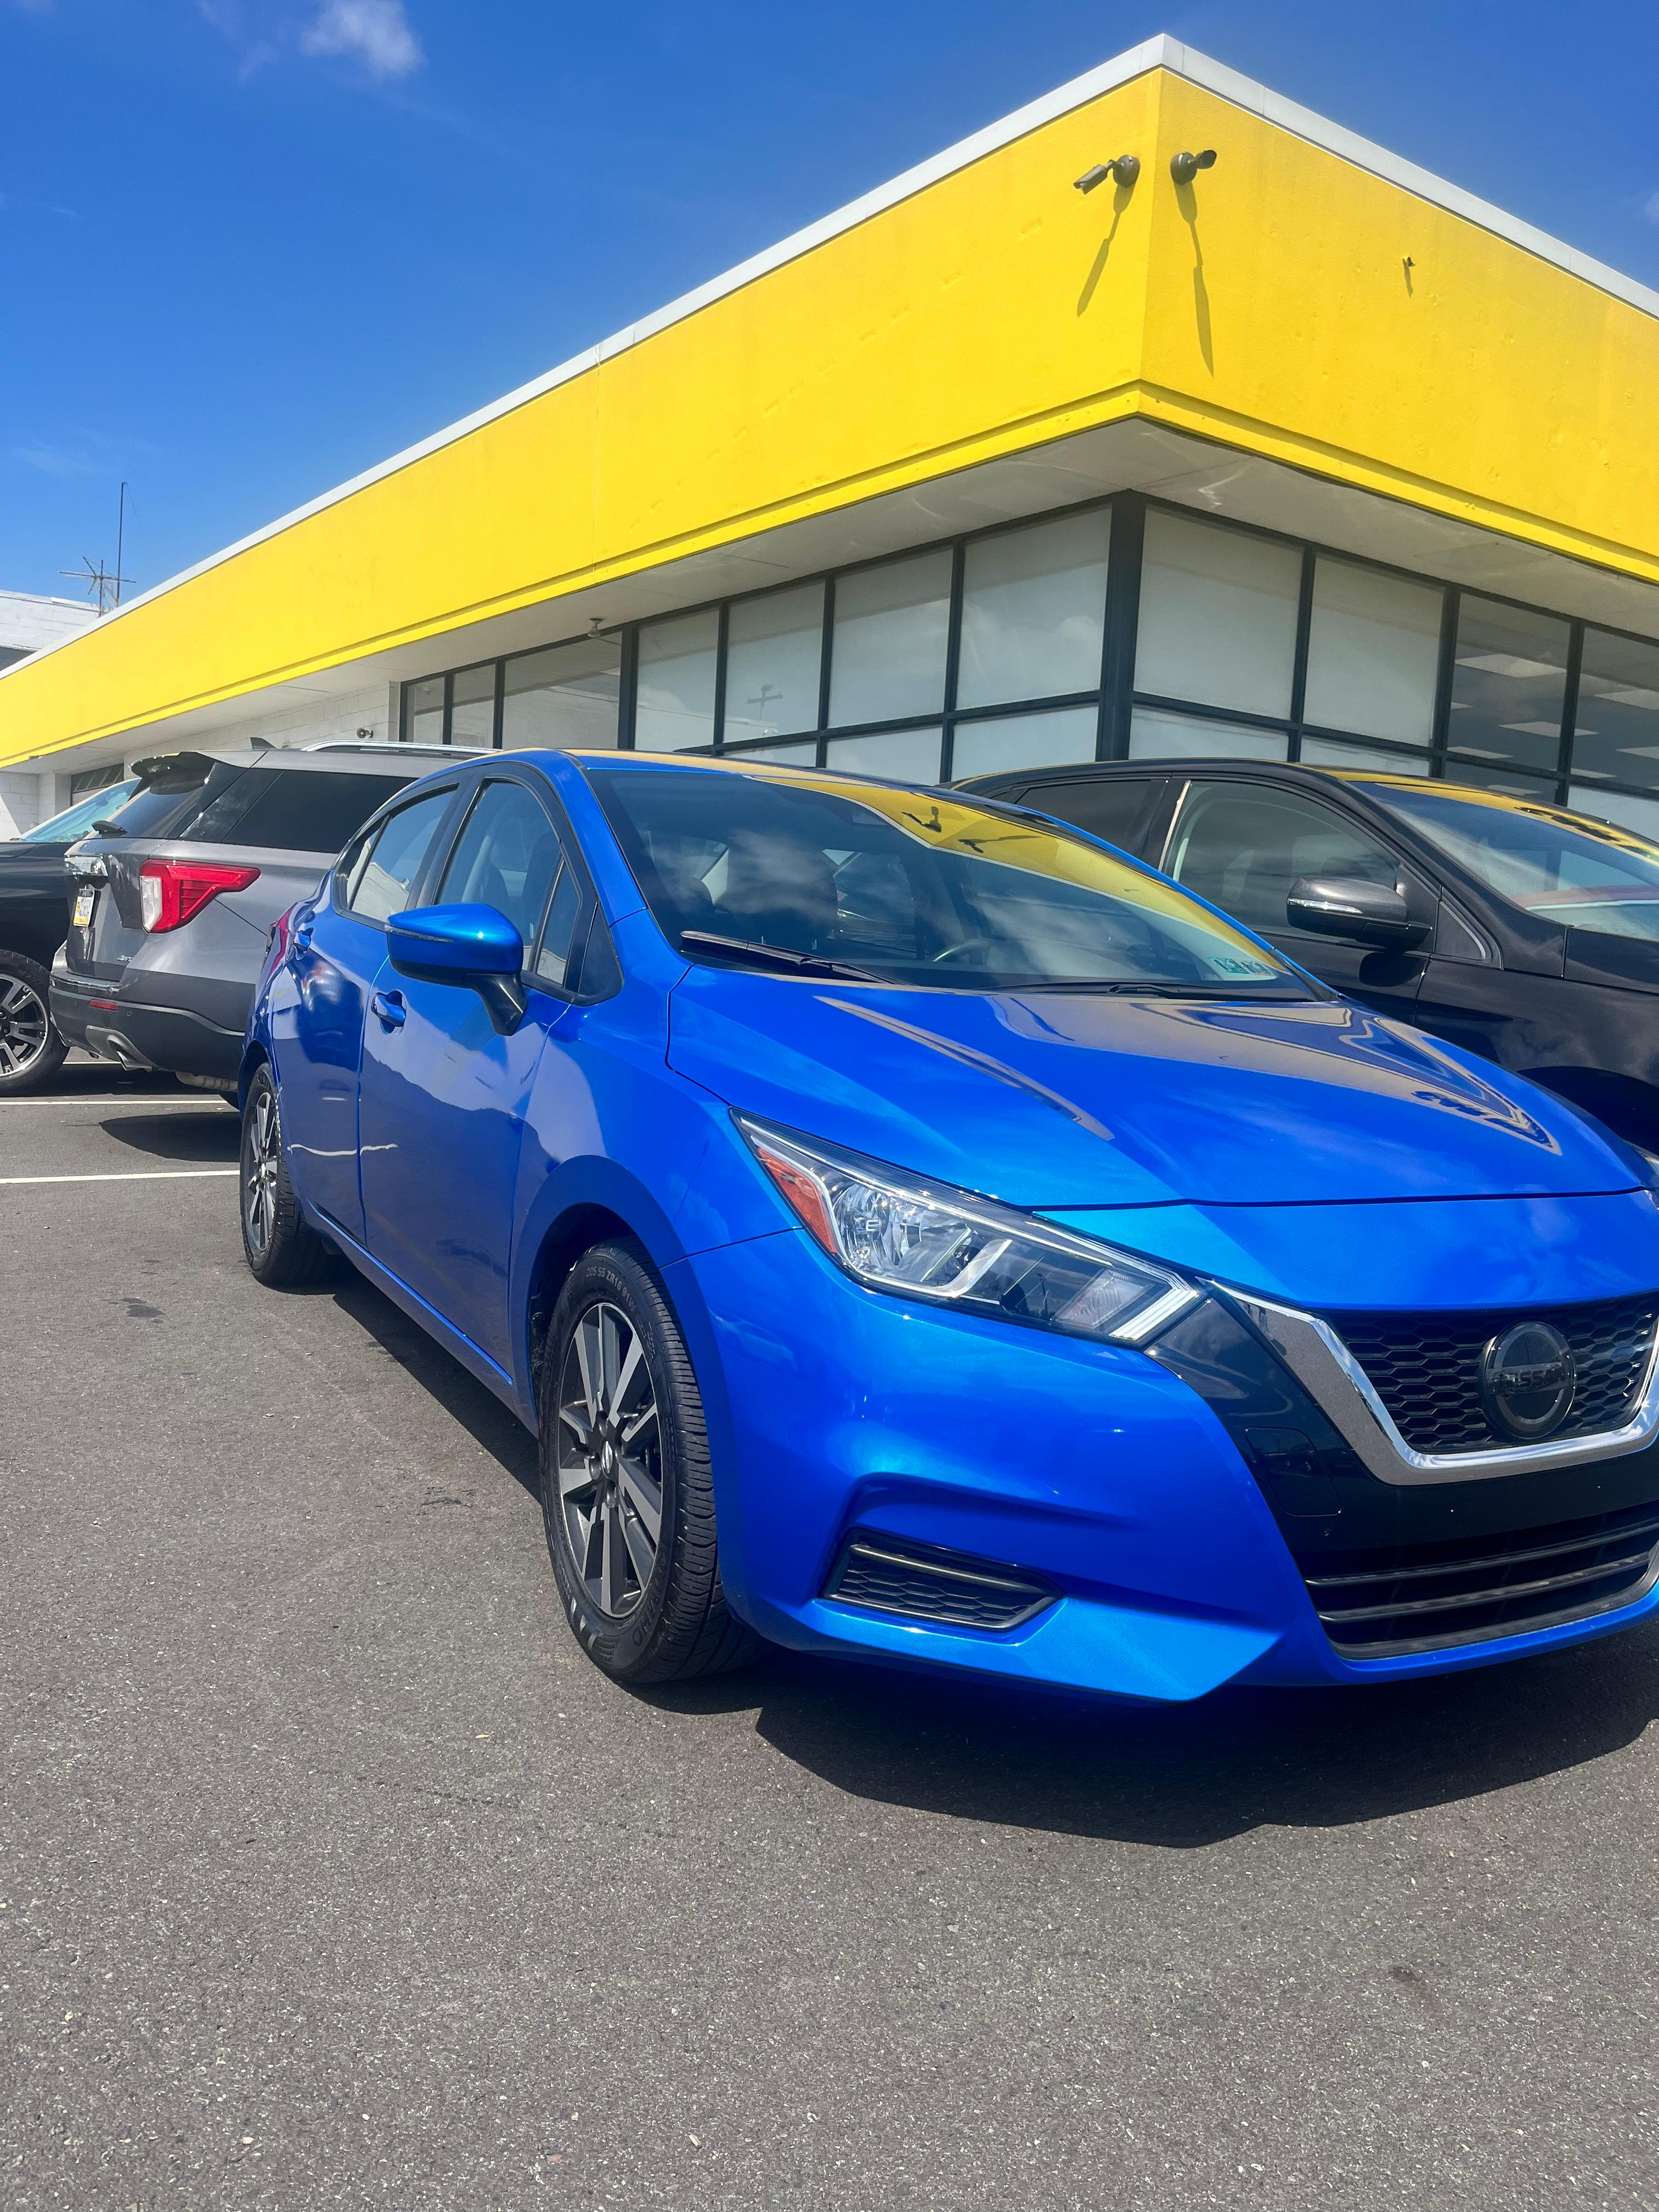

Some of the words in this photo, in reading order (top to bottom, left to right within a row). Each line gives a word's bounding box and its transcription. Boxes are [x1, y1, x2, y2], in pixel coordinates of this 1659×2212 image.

[586, 1266, 597, 1277] 205
[597, 1267, 606, 1278] 55
[606, 1270, 622, 1291] ZR16
[621, 1287, 636, 1312] 91W
